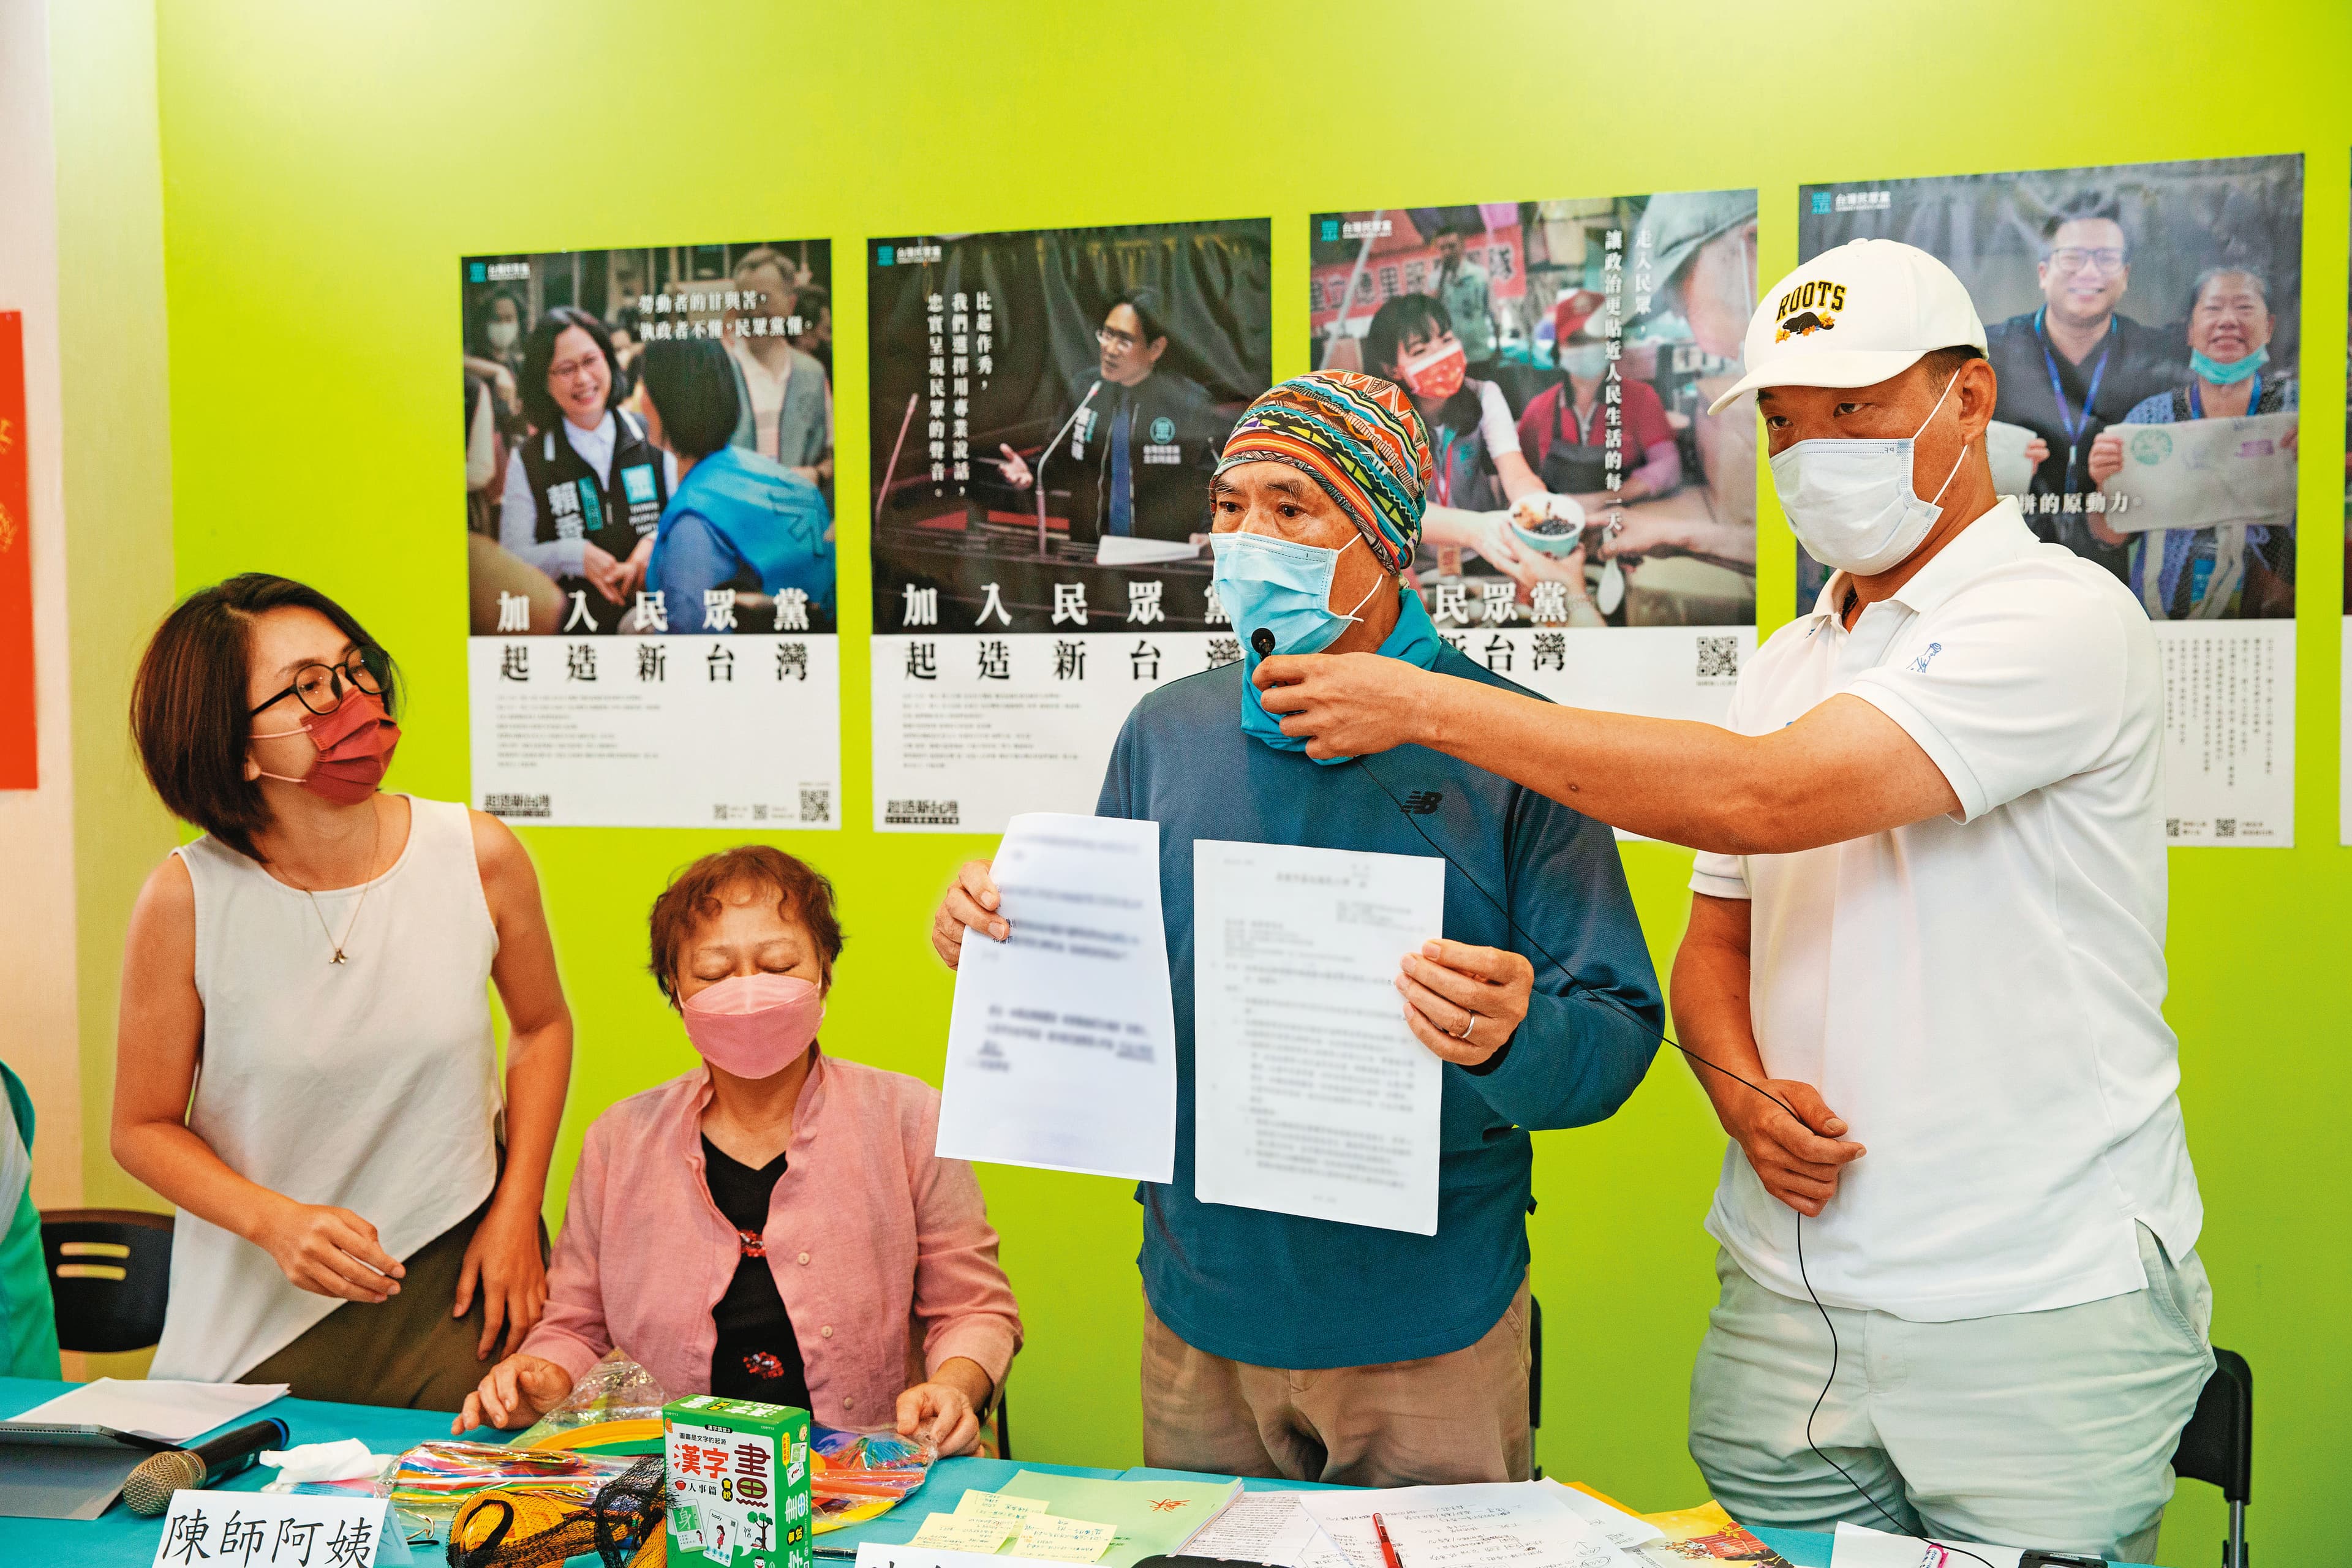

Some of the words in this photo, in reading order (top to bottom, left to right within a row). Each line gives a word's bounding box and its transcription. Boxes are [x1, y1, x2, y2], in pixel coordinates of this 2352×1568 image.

[1776, 280, 1847, 323] ROOTS
[497, 588, 809, 632] 加入民眾黨
[1433, 581, 1568, 624] 民眾黨
[499, 643, 809, 682] 起造新台灣
[1439, 633, 1566, 671] 台灣
[673, 1444, 729, 1479] 漢字
[688, 1482, 717, 1496] 人事篇
[711, 1512, 722, 1521] body
[162, 1508, 374, 1568] 陳師阿姨
